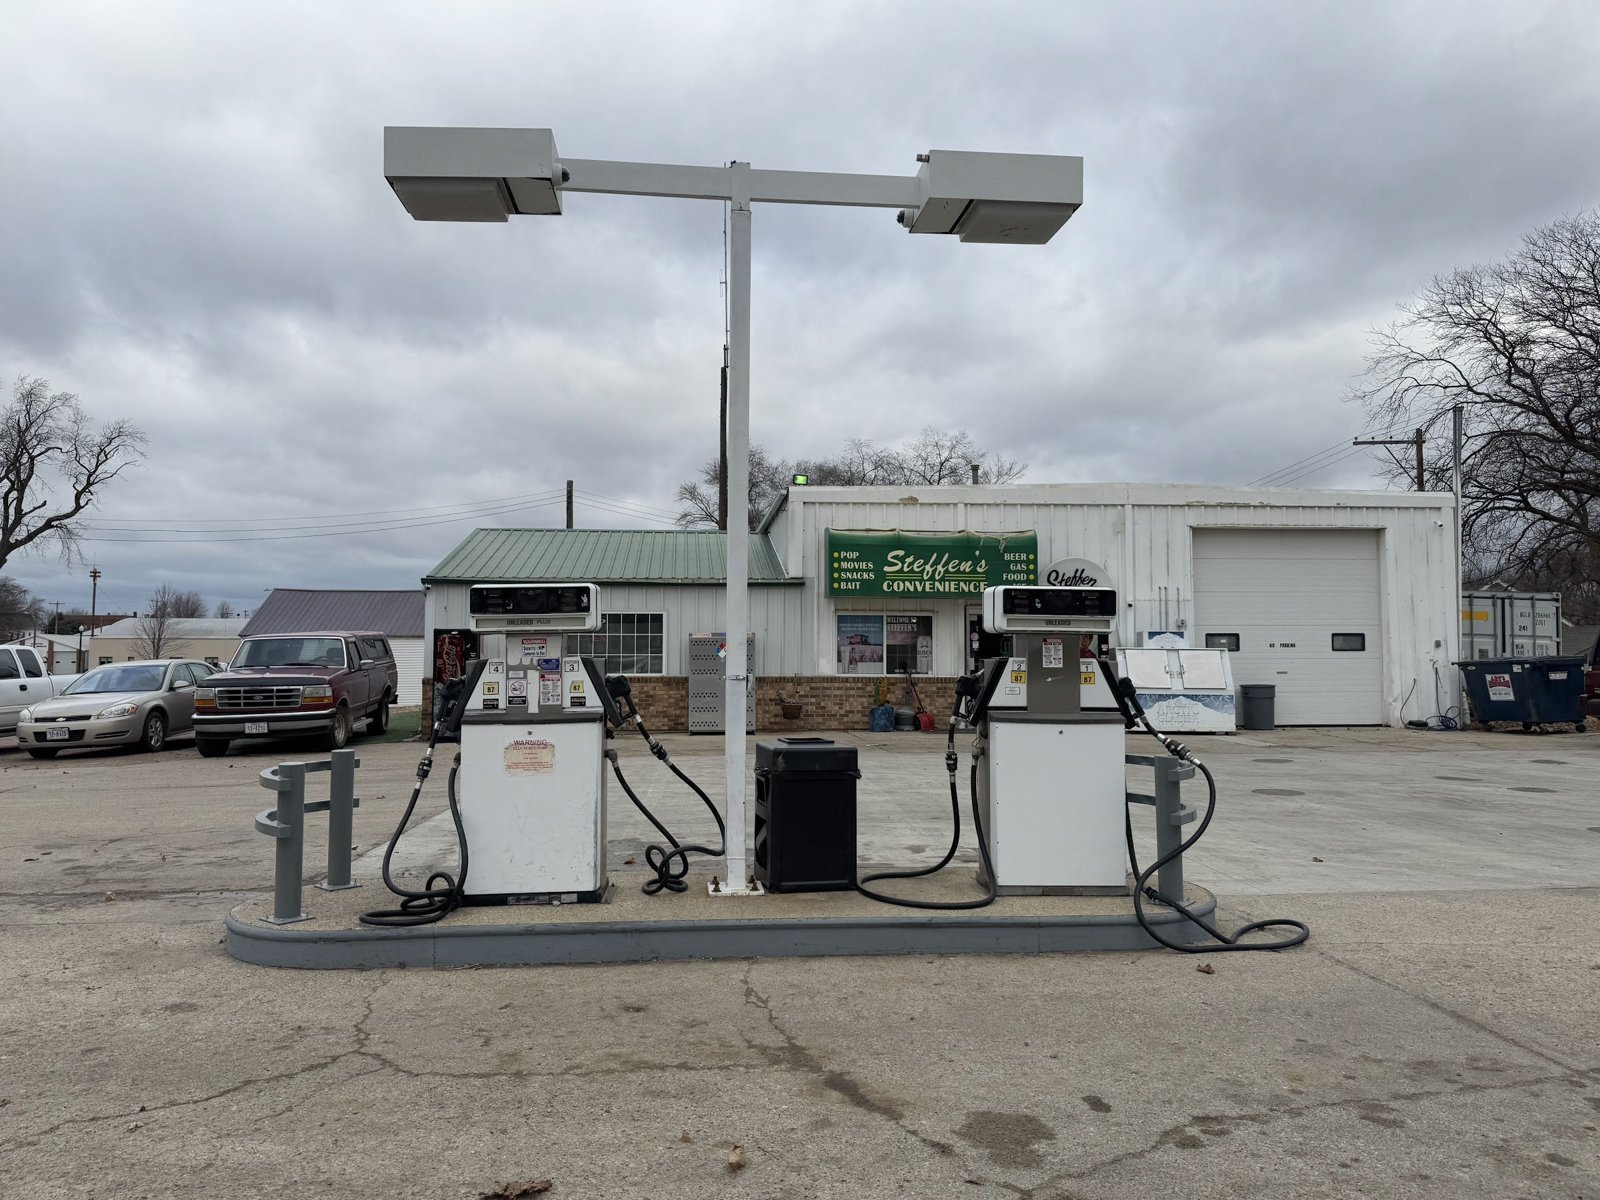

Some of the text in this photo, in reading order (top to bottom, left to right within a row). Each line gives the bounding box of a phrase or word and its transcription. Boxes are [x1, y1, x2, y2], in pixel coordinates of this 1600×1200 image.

[840, 551, 859, 559] POP
[1004, 553, 1027, 561] BEER
[840, 561, 874, 570] MOVIES
[883, 550, 989, 580] Steffen's
[1010, 563, 1027, 571] GAS
[840, 571, 875, 580] SNACKS
[1003, 573, 1027, 581] FOOD
[840, 581, 861, 590] BAIT
[882, 581, 988, 592] CONVENIENCE
